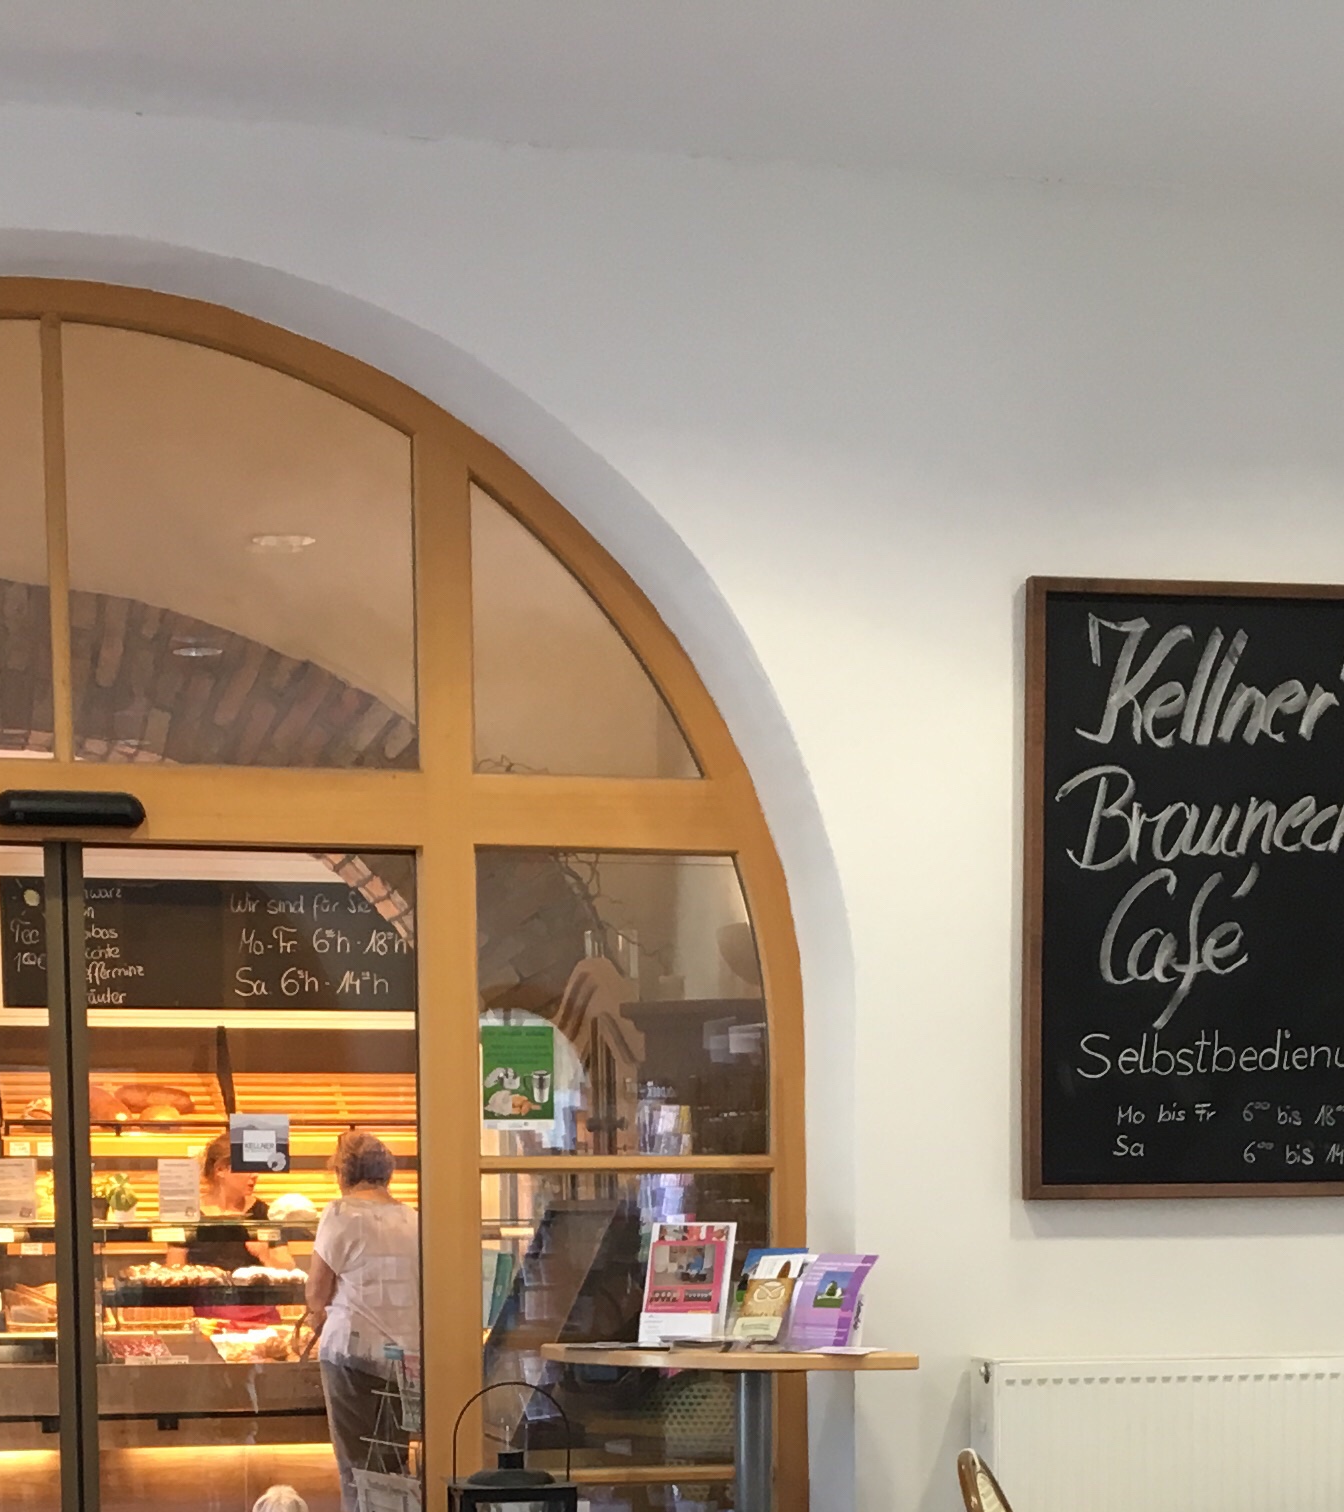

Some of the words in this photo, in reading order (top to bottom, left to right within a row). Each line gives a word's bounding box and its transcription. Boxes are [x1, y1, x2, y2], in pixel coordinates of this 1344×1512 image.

[230, 892, 260, 914] Wir
[266, 893, 304, 915] sind
[312, 892, 339, 922] für
[1099, 862, 1260, 1029] Café
[1116, 1105, 1145, 1126] Mo
[1157, 1103, 1185, 1123] bis
[1194, 1103, 1217, 1122] Fr
[1277, 1104, 1302, 1126] bis
[1112, 1134, 1146, 1158] Sa
[1285, 1143, 1314, 1166] bis
